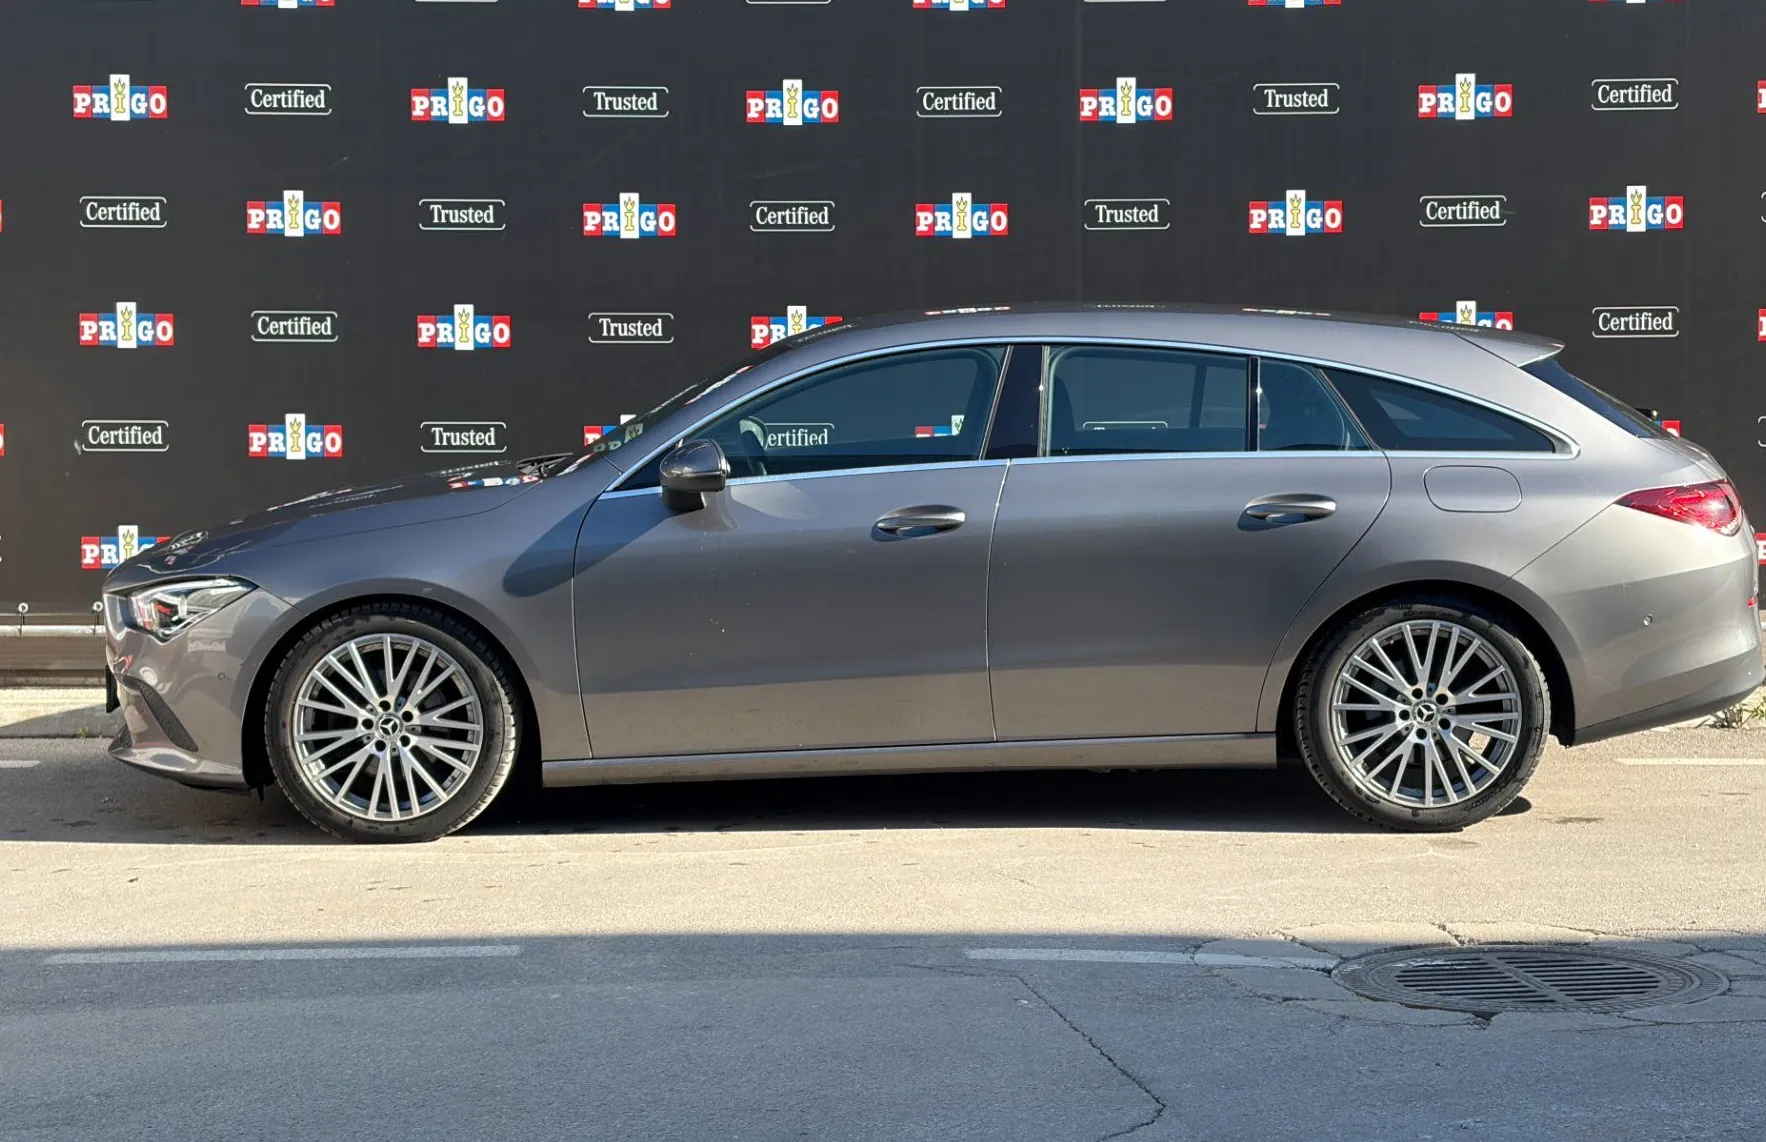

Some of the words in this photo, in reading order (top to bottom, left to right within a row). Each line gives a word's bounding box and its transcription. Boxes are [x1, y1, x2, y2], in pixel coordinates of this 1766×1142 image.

[73, 77, 167, 115] PRIGO
[250, 88, 326, 109] Certified
[411, 81, 505, 117] PRIGO
[592, 91, 658, 111] Trusted
[746, 83, 839, 119] PRIGO
[922, 91, 997, 111] Certified
[1080, 80, 1172, 117] PRIGO
[1263, 88, 1329, 108] Trusted
[1418, 76, 1512, 113] PRIGO
[1597, 83, 1673, 104] Certified
[85, 201, 161, 222] Certified
[247, 194, 341, 230] PRIGO
[429, 204, 495, 224] Trusted
[583, 196, 676, 232] PRIGO
[755, 205, 830, 225] Certified
[916, 196, 1008, 232] PRIGO
[1094, 203, 1159, 223] Trusted
[1249, 193, 1342, 229] PRIGO
[1425, 200, 1501, 221] Certified
[1589, 189, 1683, 225] PRIGO
[80, 305, 173, 342] PRIGO
[256, 315, 333, 336] Certified
[418, 308, 510, 344] PRIGO
[598, 317, 663, 337] Trusted
[1598, 311, 1674, 332] Certified
[87, 425, 164, 445] Certified
[249, 417, 342, 453] PRIGO
[430, 426, 497, 446] Trusted
[766, 428, 829, 447] ertified
